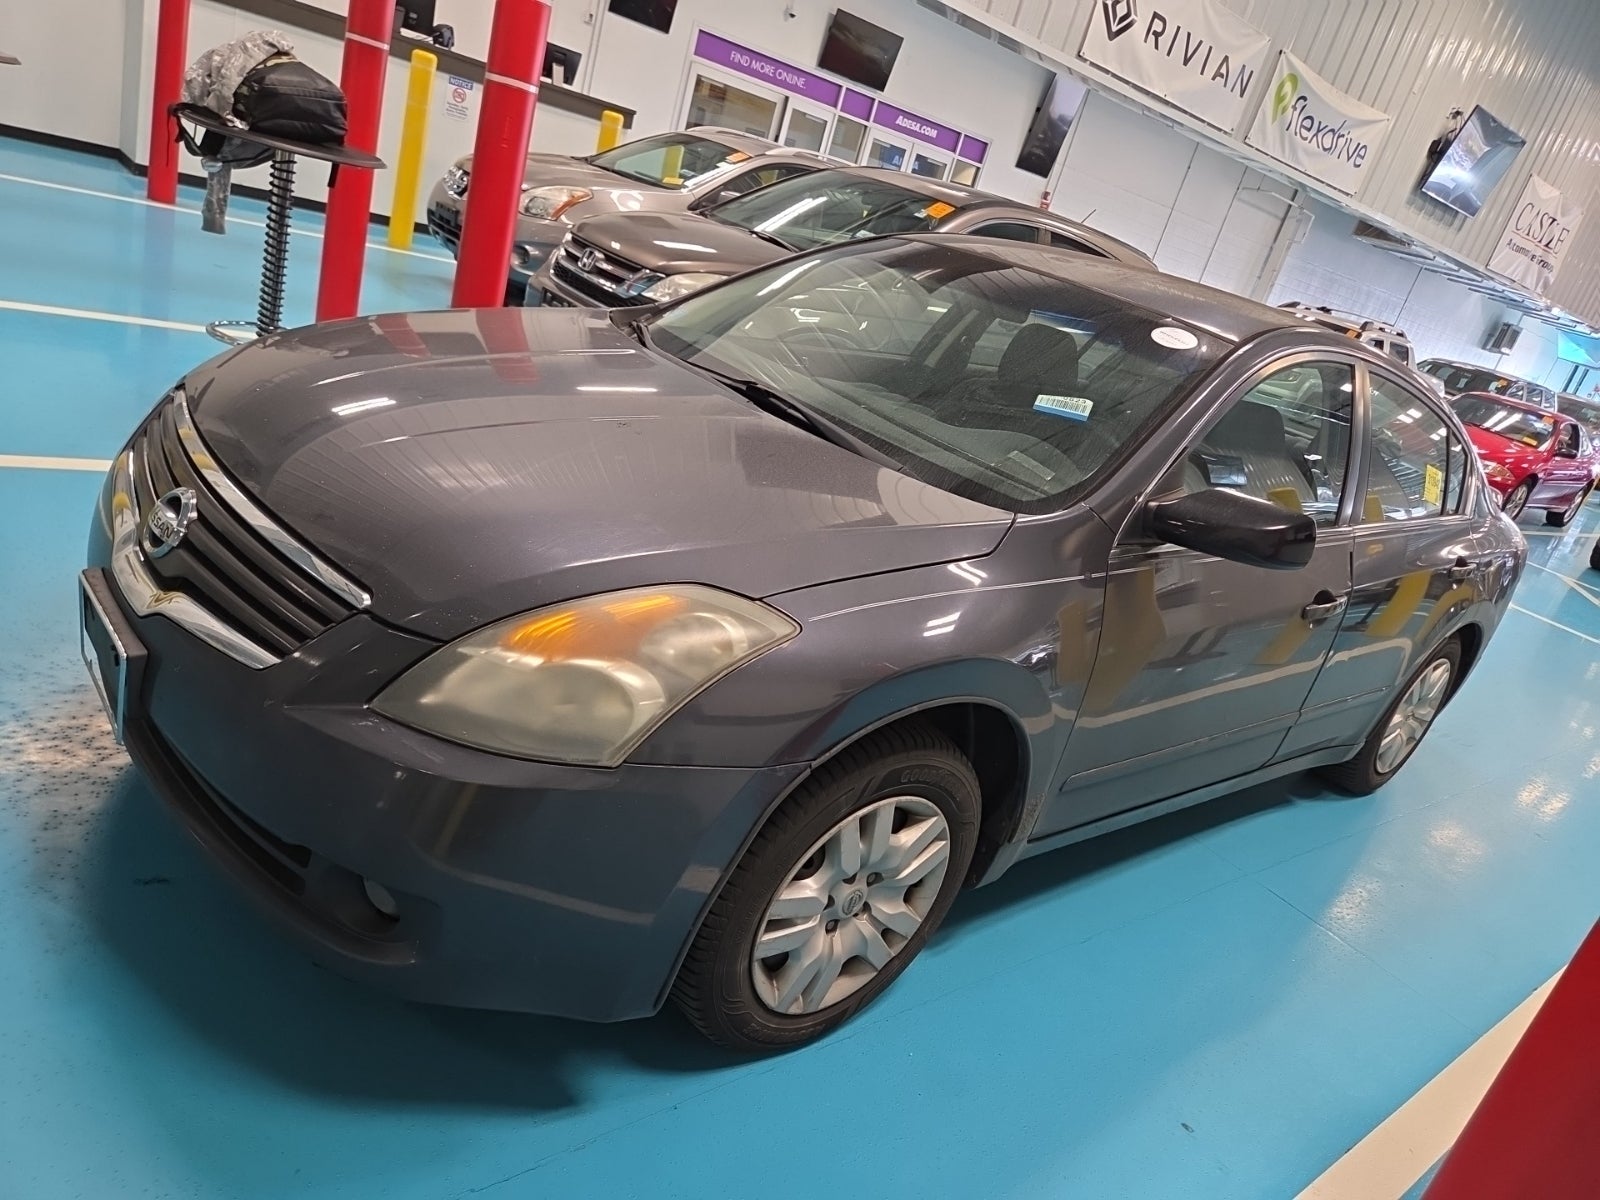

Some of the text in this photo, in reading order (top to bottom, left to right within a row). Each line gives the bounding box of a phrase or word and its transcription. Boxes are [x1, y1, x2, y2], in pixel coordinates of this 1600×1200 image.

[730, 51, 807, 89] FIND MORE ONLINE.
[1144, 10, 1254, 98] RIVIAN
[895, 115, 938, 139] ADESA.COM
[1285, 95, 1368, 168] flexdrive
[151, 512, 175, 540] SSAN
